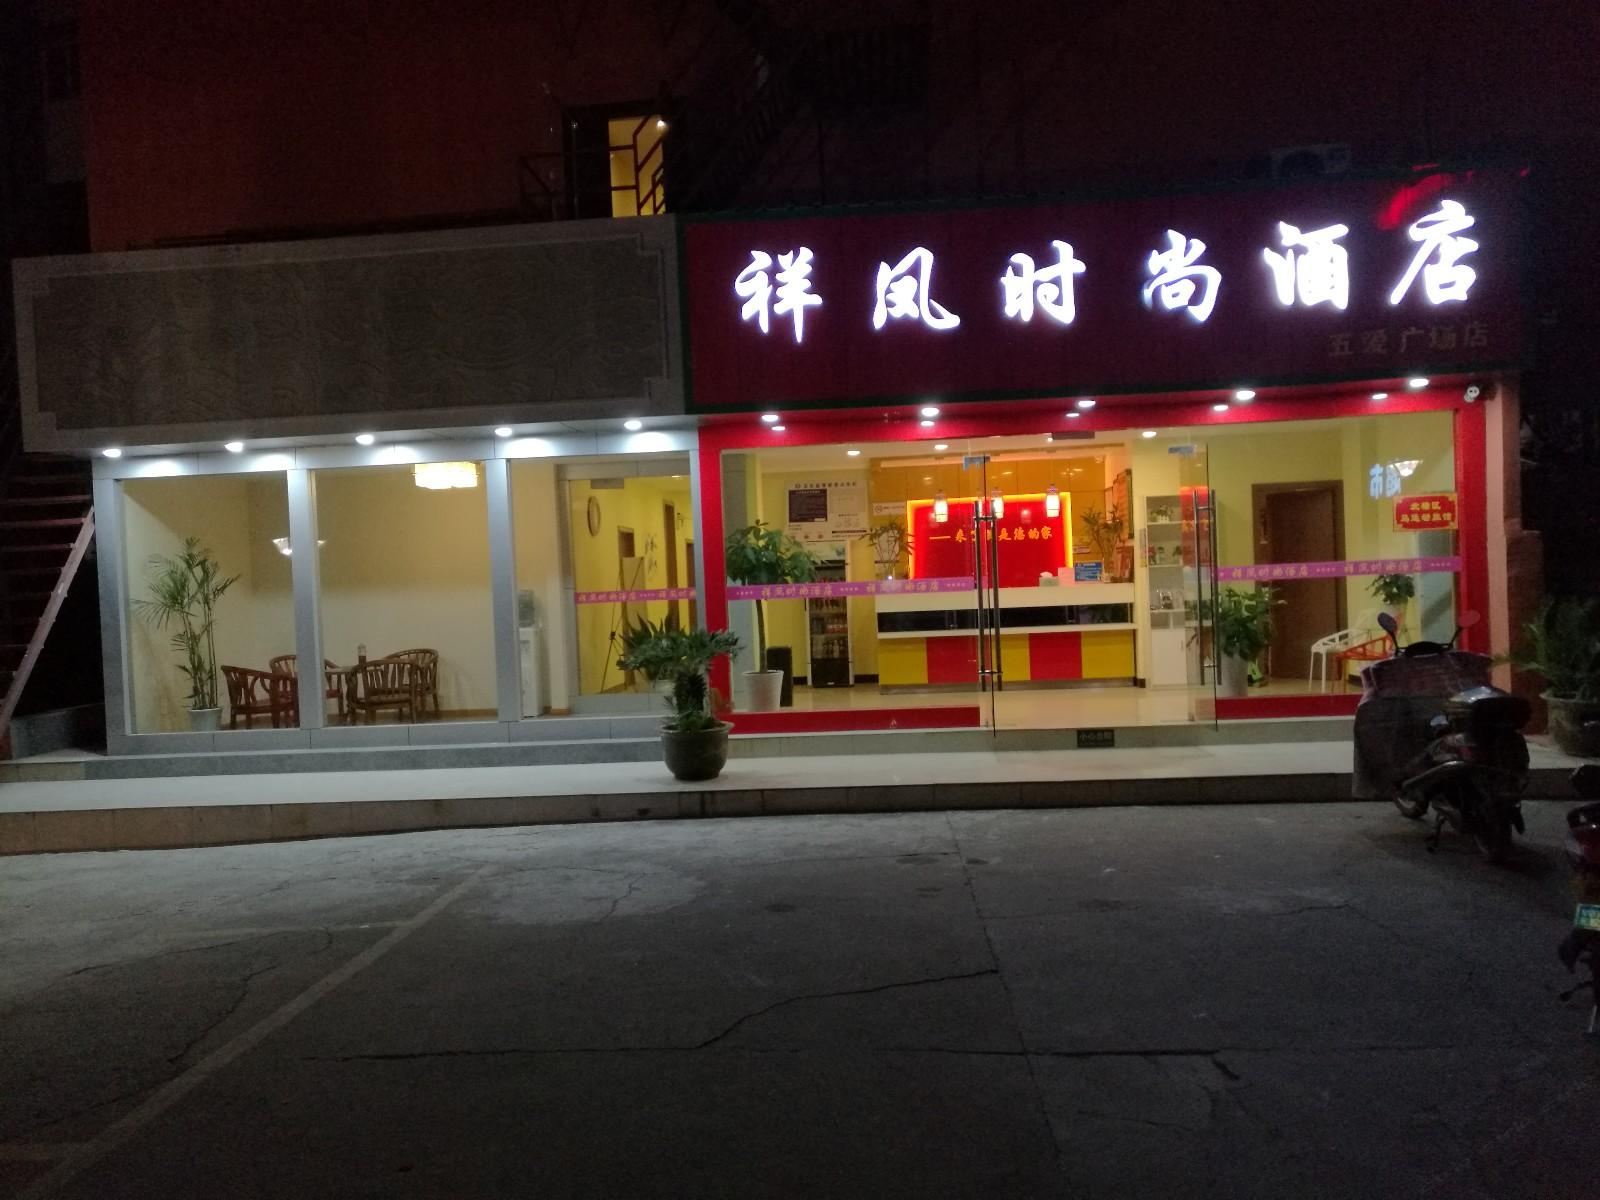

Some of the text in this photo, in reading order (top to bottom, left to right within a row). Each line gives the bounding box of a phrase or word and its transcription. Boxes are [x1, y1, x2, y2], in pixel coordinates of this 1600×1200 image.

[734, 198, 1480, 344] 祥凤时尚酒店
[1328, 320, 1490, 356] 五爱广场店
